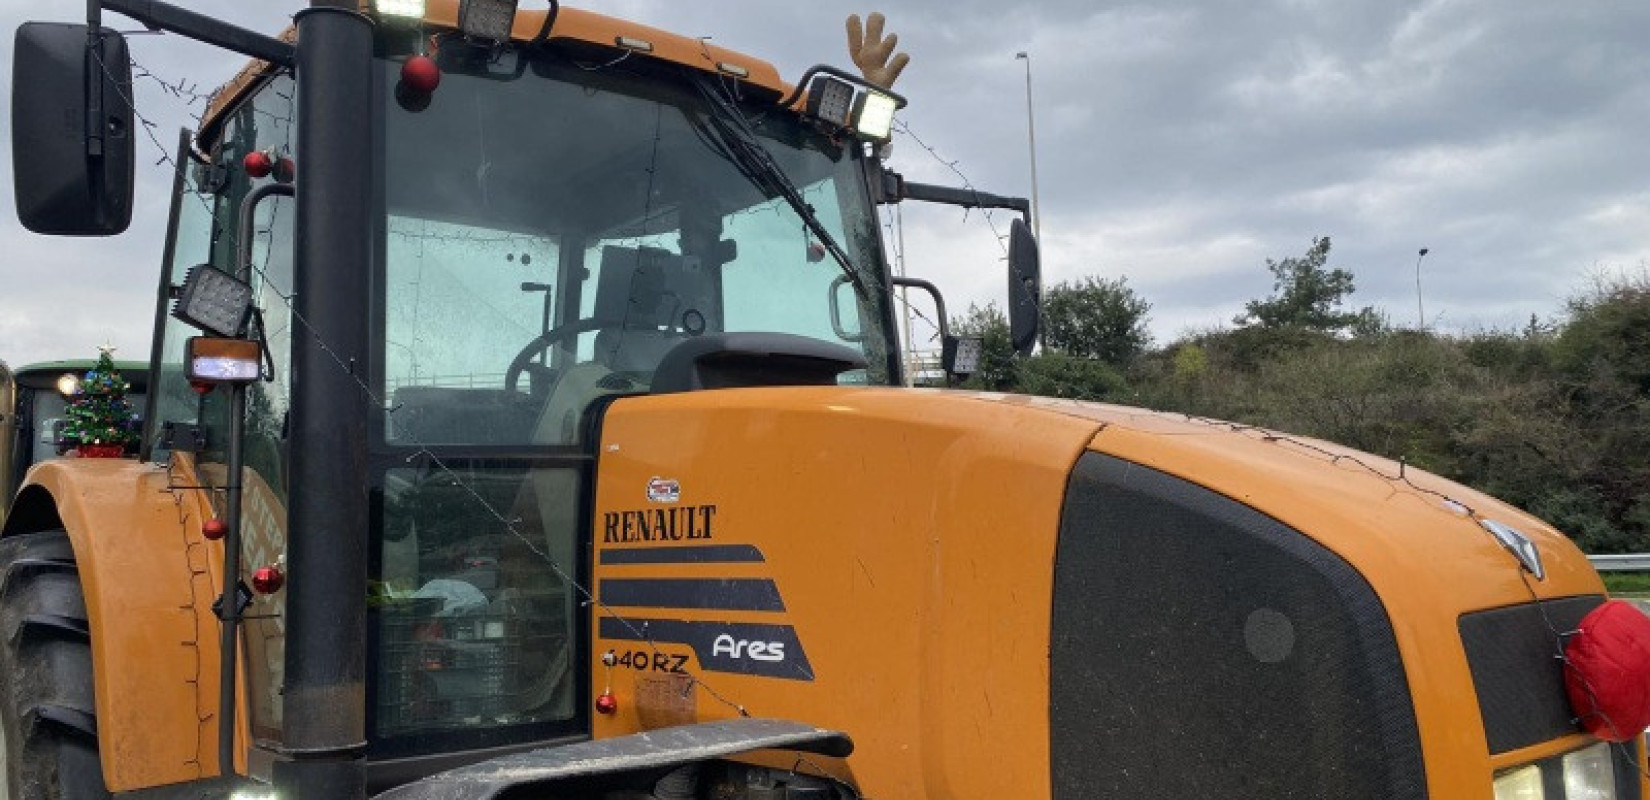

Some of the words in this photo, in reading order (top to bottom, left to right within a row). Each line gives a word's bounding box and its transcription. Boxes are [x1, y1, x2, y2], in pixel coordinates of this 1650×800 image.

[603, 505, 716, 542] RENAULT
[713, 634, 785, 661] Ares
[652, 651, 690, 675] RZ
